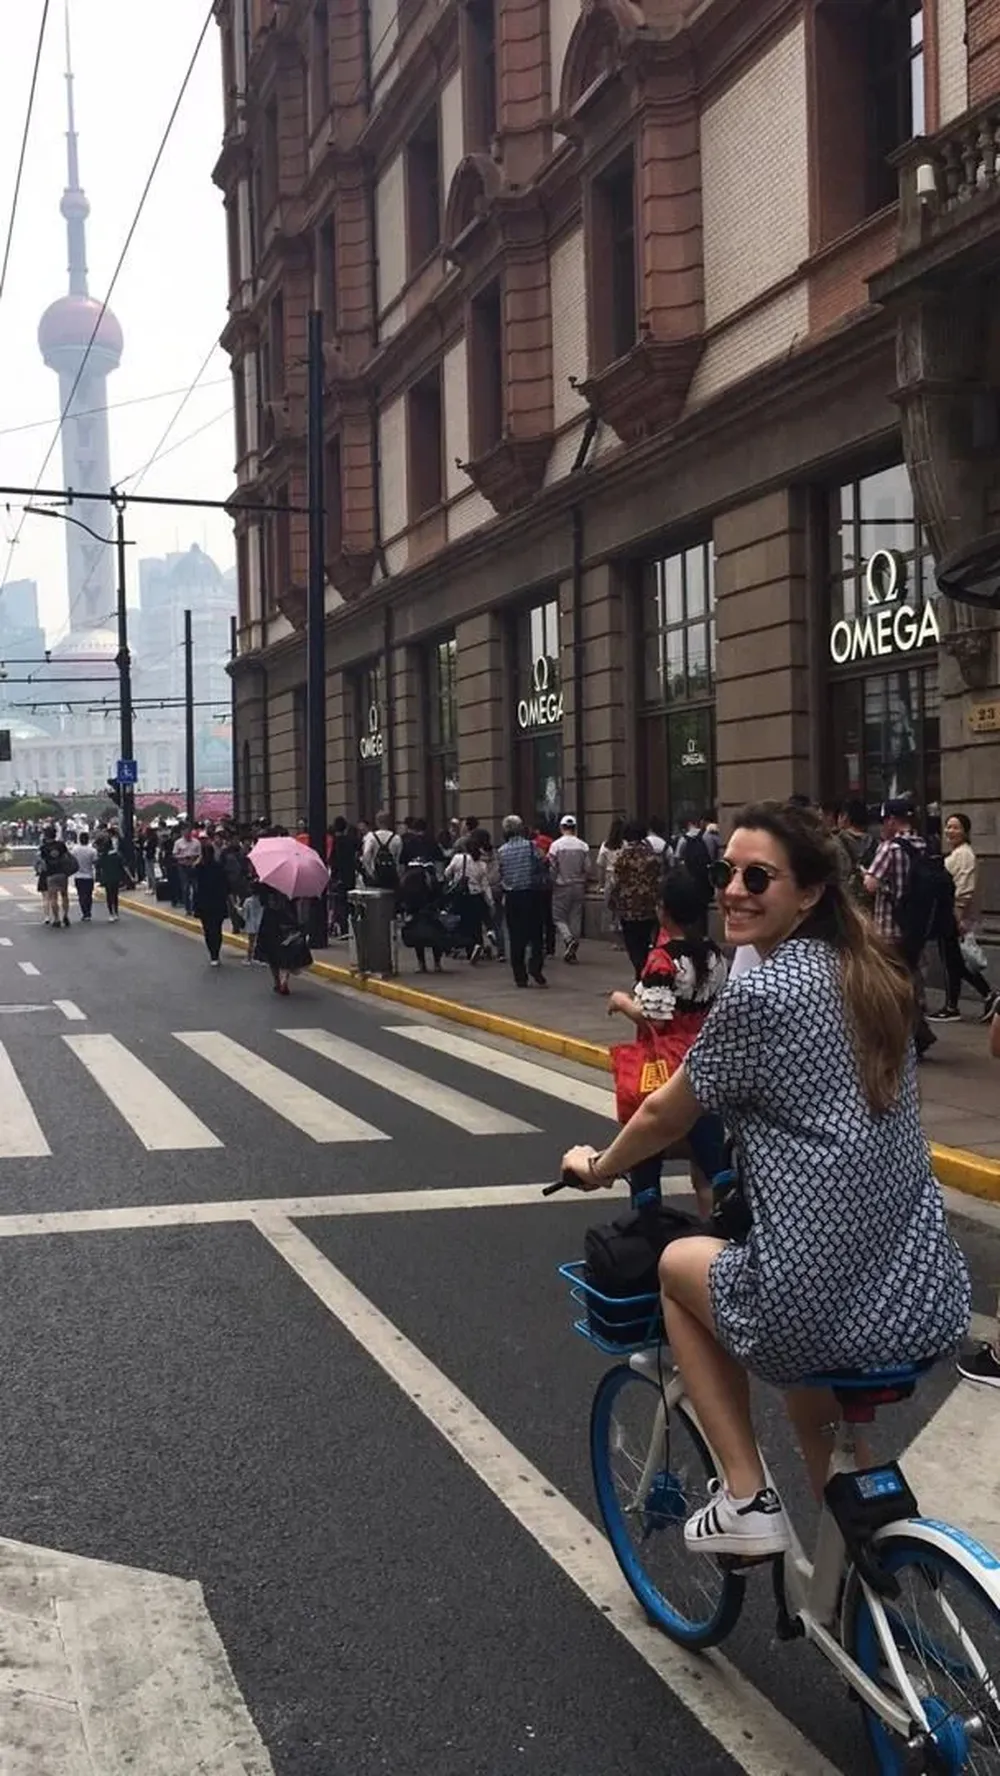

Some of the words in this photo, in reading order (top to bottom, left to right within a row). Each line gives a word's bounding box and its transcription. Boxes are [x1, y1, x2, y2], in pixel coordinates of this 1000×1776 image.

[831, 600, 940, 664] OMEGA
[978, 708, 995, 720] 23
[360, 734, 383, 758] OMEG
